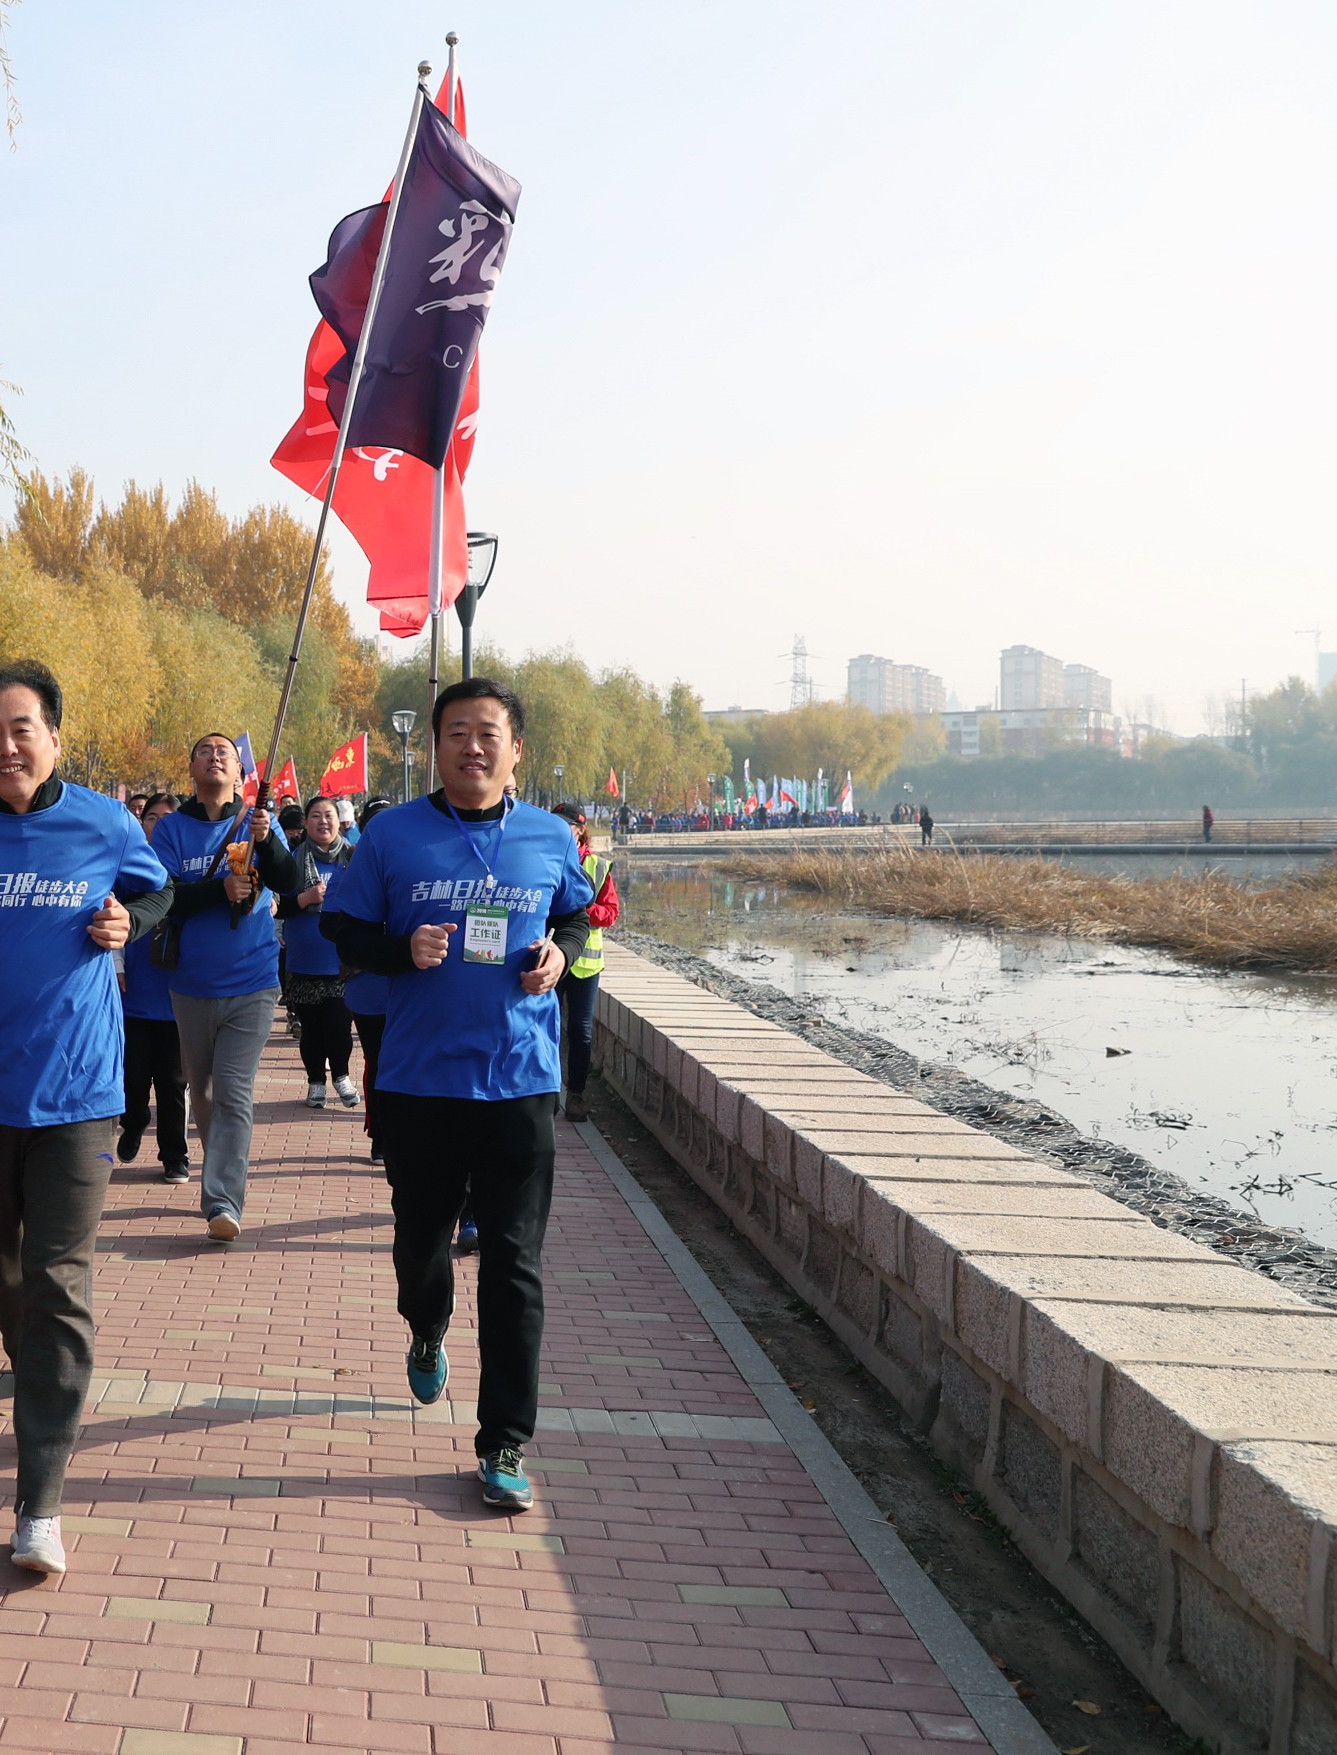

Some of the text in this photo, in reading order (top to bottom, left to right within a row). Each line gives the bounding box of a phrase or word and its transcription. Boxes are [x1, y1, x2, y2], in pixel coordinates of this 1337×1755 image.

[31, 894, 83, 908] 心中有你
[470, 927, 502, 940] 工作证
